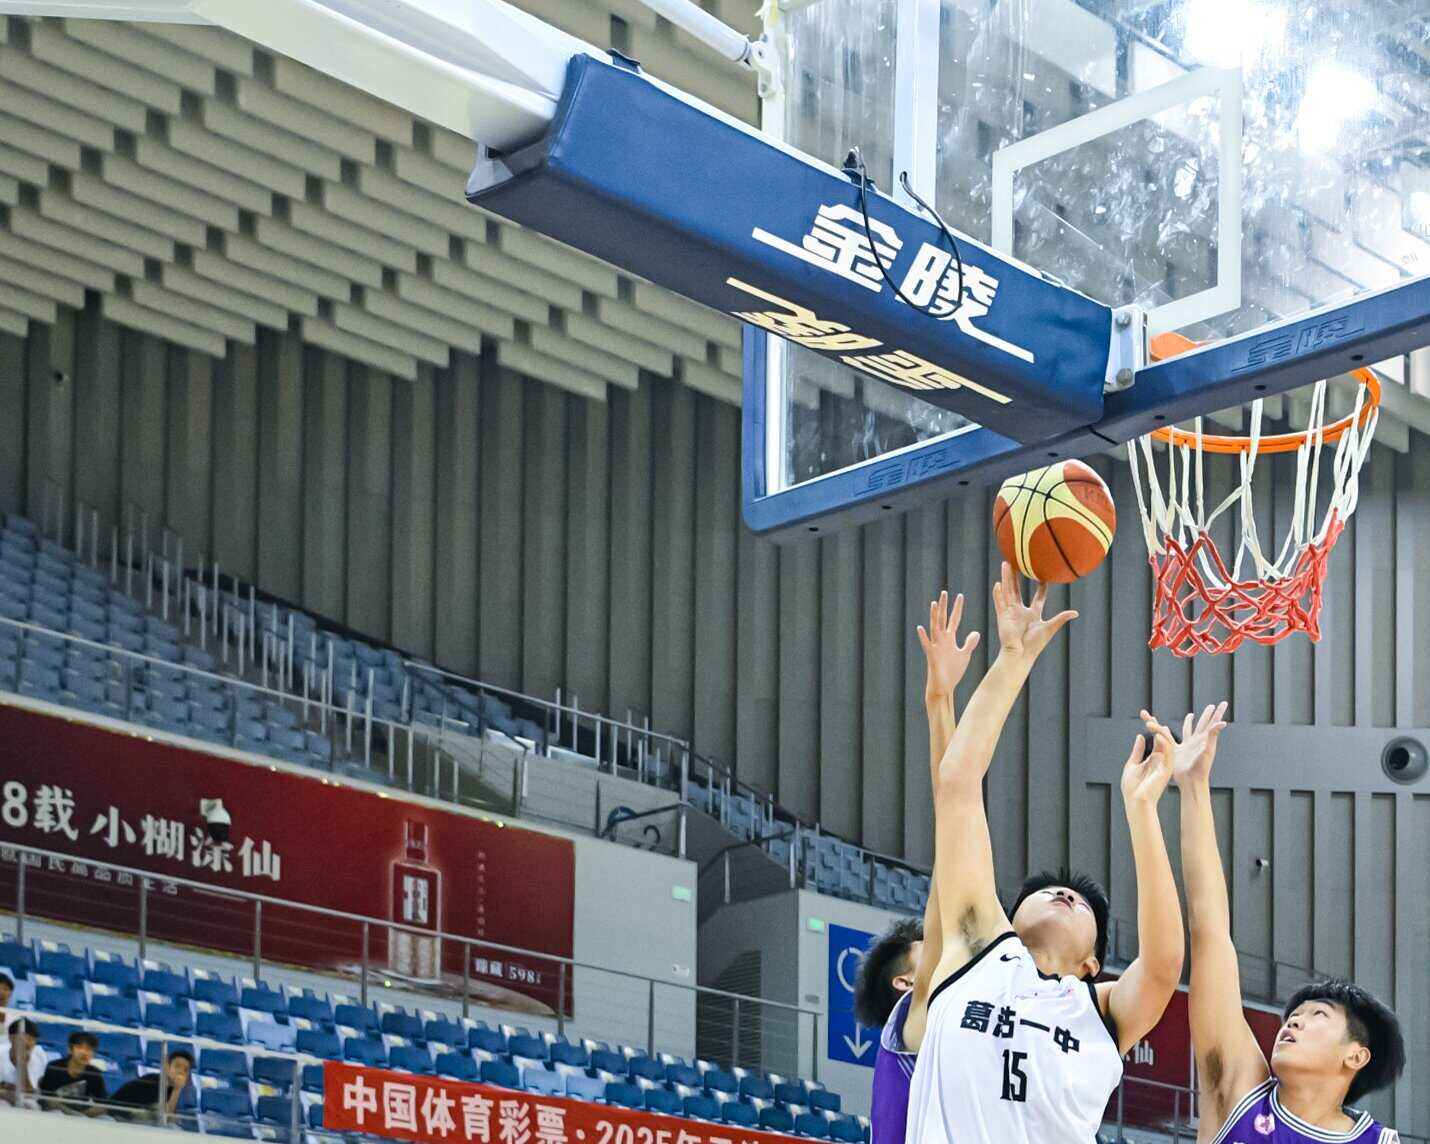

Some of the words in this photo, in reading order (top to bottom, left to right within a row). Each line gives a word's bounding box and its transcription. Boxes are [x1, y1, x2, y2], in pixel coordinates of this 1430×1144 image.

[90, 805, 281, 881] 小糊涂仙
[960, 1000, 1080, 1054] 葛沽一中
[1000, 1049, 1028, 1102] 15
